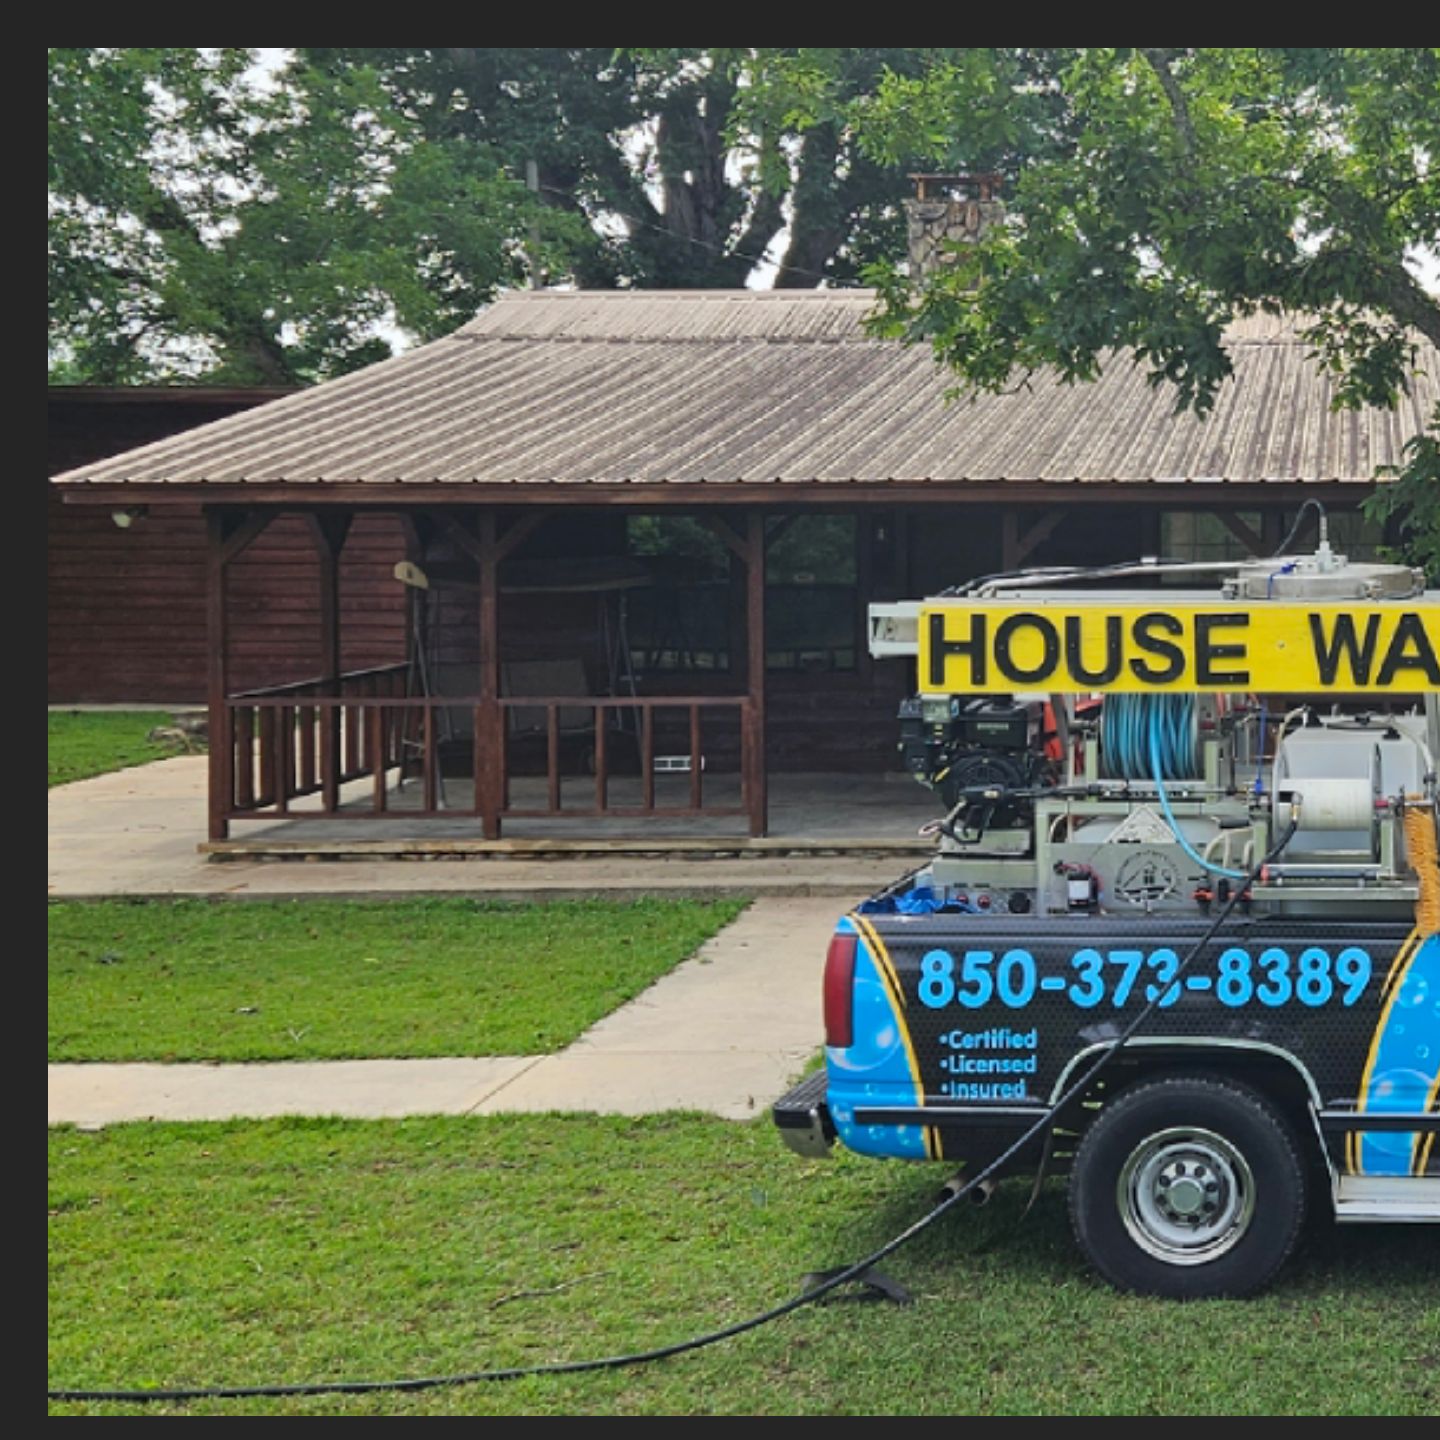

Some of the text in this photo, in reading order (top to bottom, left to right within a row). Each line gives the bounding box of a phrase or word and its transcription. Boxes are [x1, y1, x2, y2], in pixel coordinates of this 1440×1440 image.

[929, 612, 1250, 685] HOUSE
[918, 947, 1372, 1008] 850-373-8389
[949, 1026, 1037, 1049] Certified
[949, 1054, 1036, 1073] Licensed
[950, 1078, 1025, 1099] Insured
